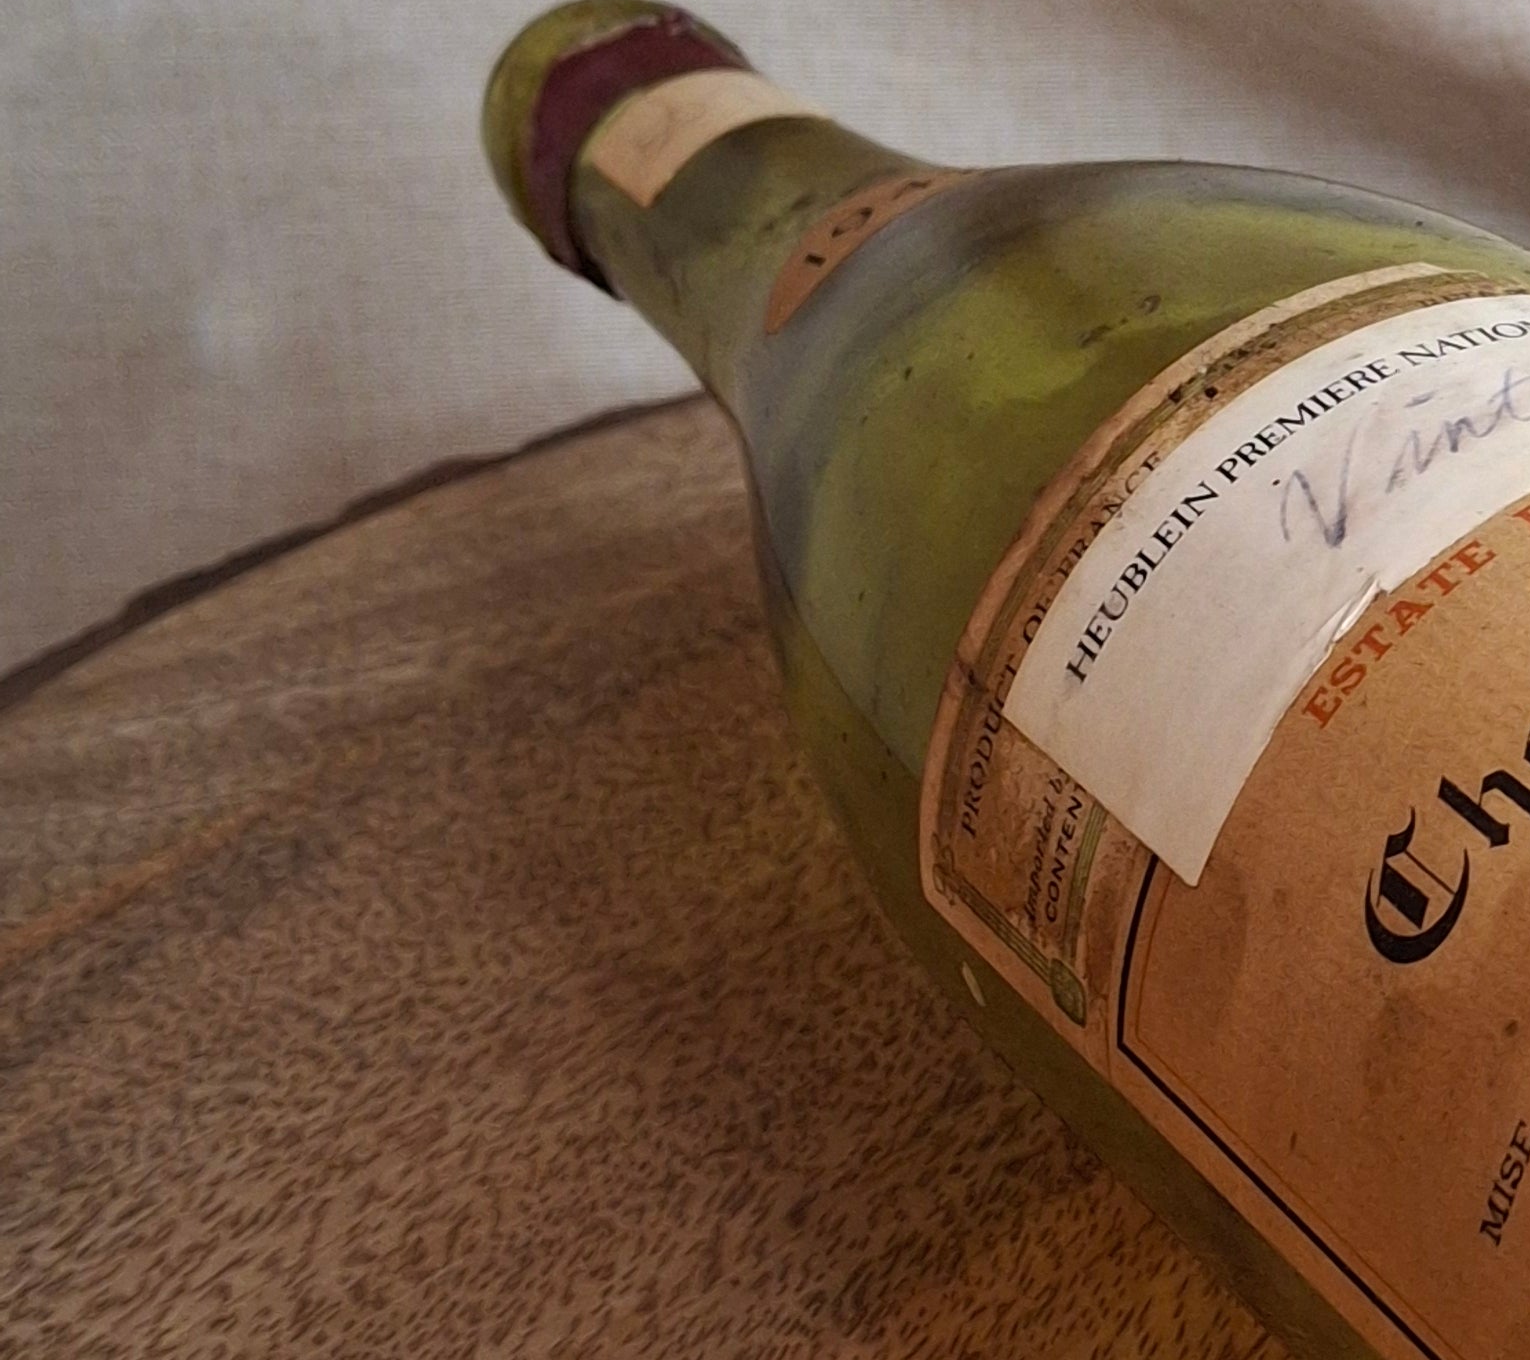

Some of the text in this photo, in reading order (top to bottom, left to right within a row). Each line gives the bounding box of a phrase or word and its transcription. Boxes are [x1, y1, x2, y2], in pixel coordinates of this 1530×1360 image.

[1065, 480, 1222, 684] HEUBLEIN
[1216, 361, 1402, 485] PREMIERE
[1302, 540, 1497, 729] ESTATE
